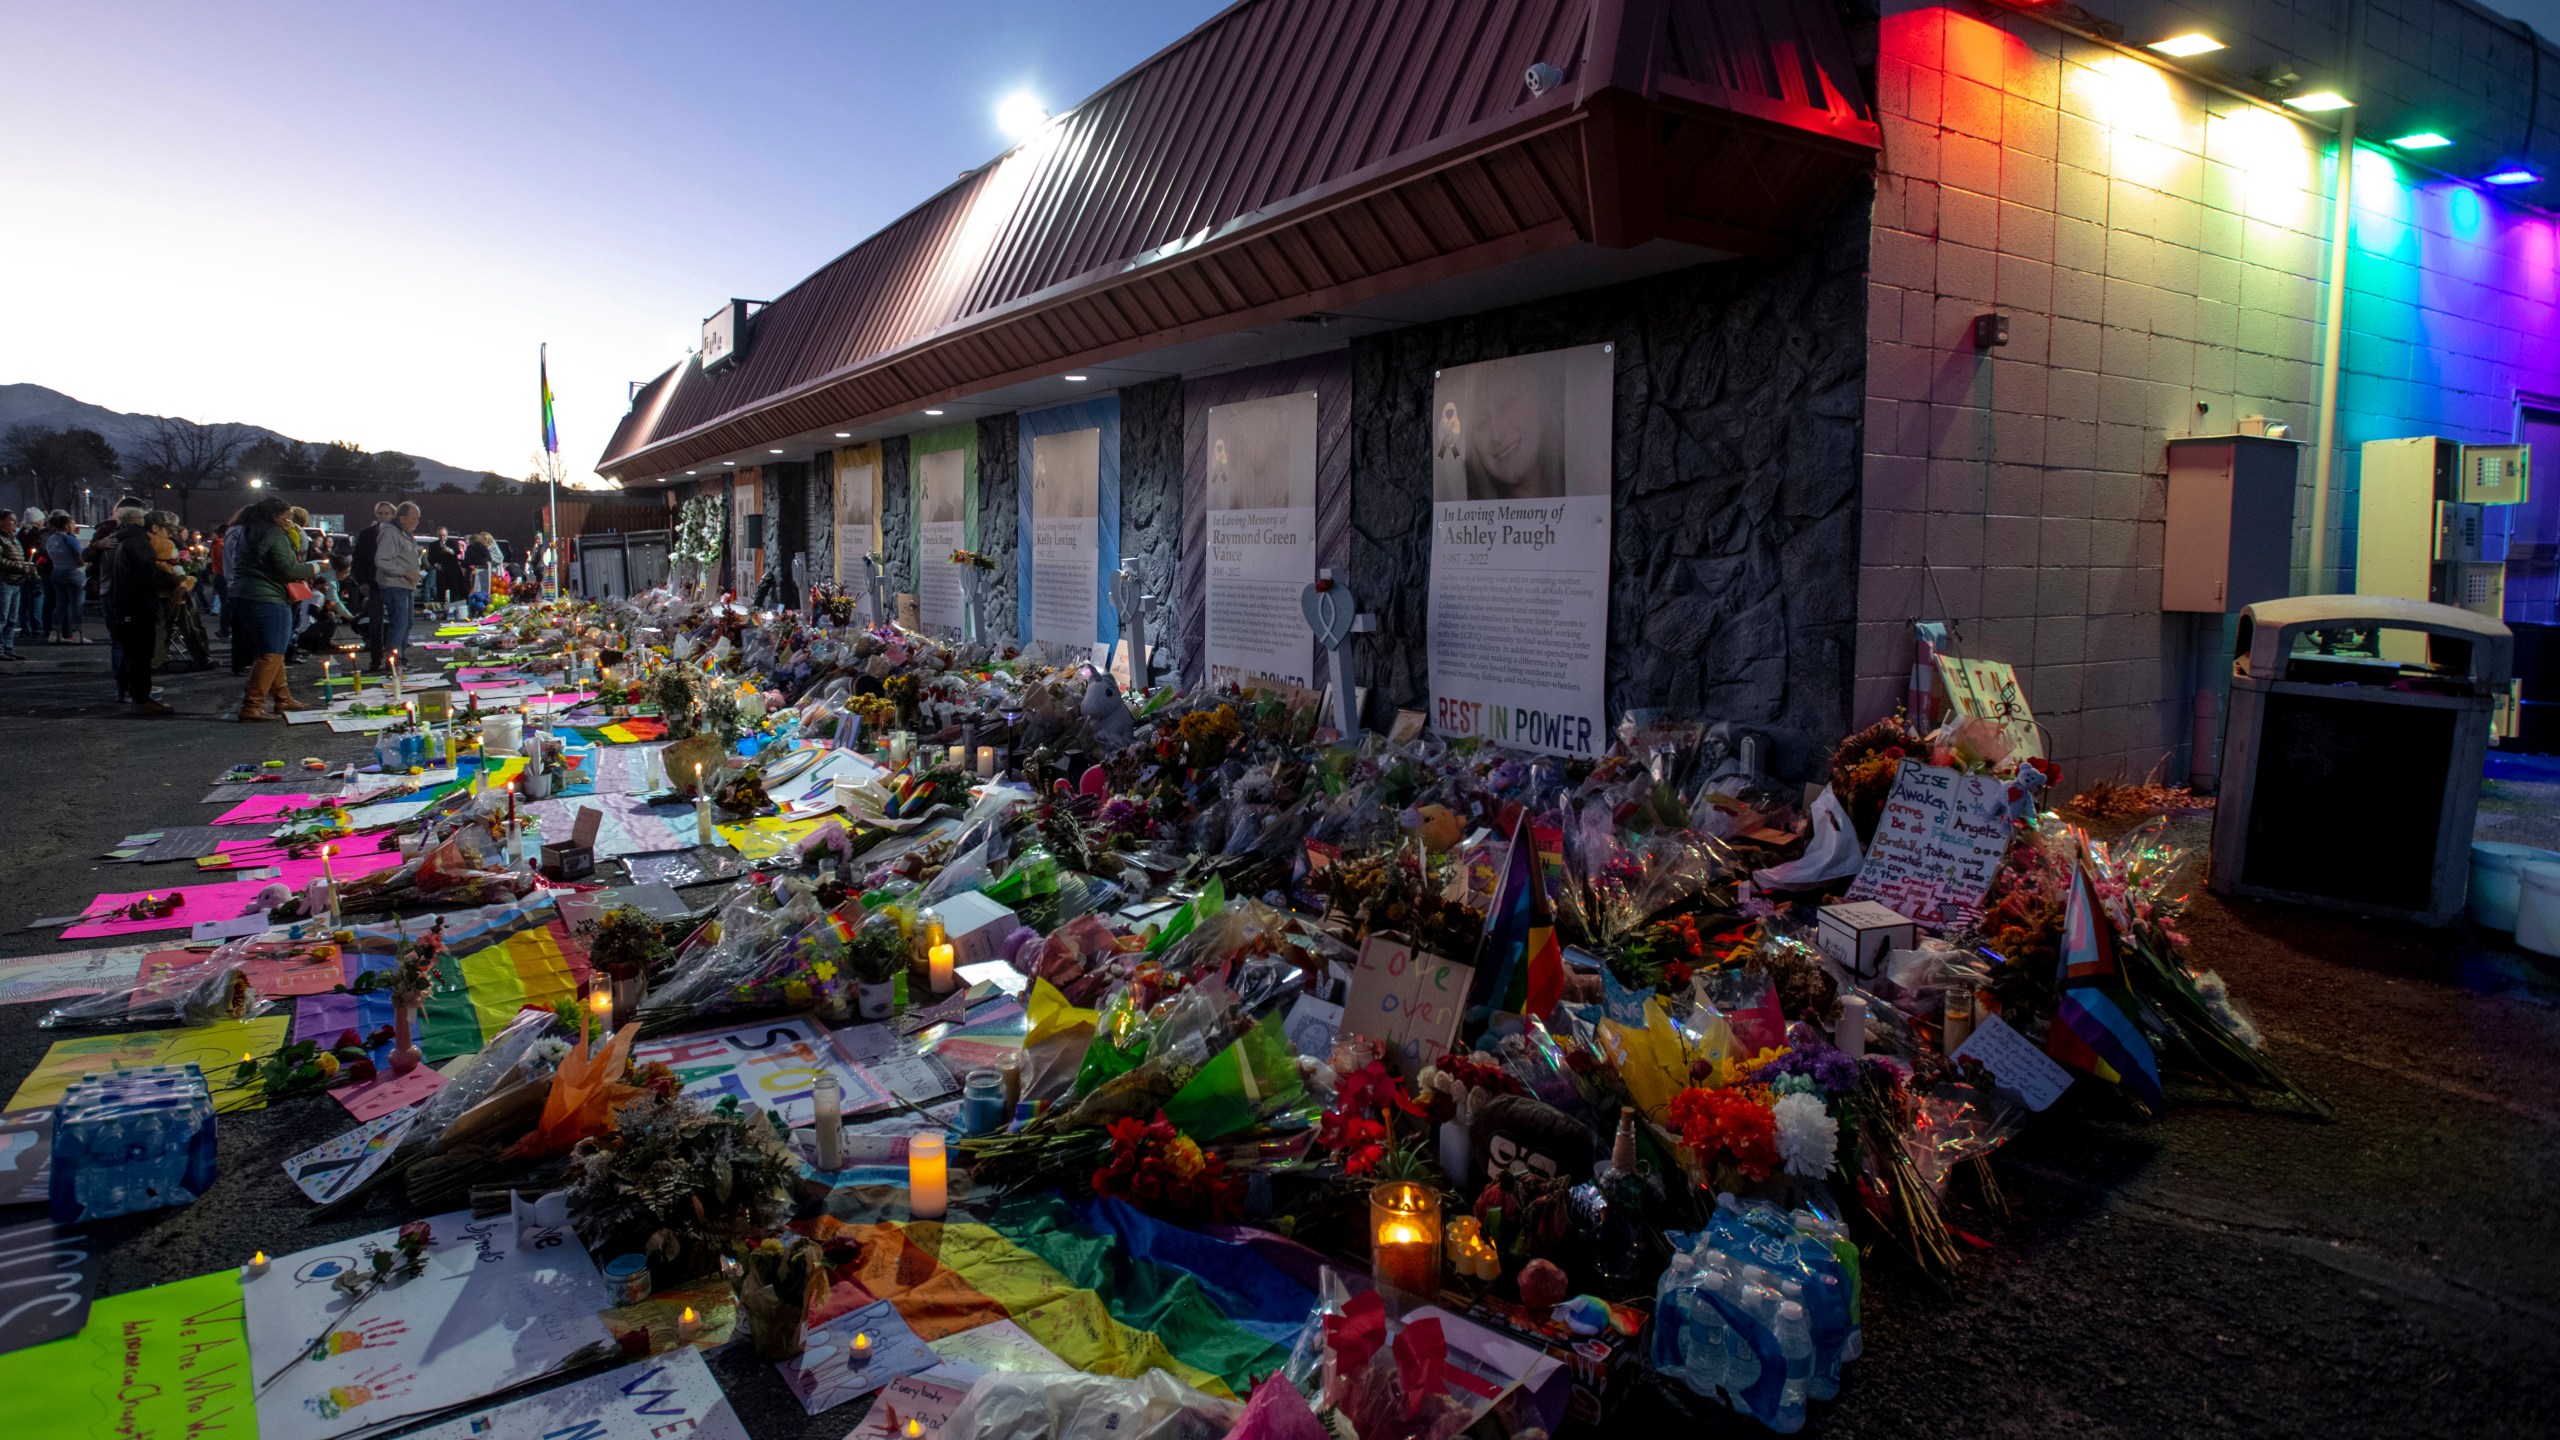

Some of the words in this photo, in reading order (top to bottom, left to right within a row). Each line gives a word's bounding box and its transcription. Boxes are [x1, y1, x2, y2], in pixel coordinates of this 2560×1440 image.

[1213, 515, 1220, 526] In
[1222, 514, 1246, 529] Loving
[1248, 514, 1278, 529] Memory
[1280, 513, 1288, 528] of
[1444, 508, 1454, 521] In
[1457, 507, 1495, 525] Loving
[1497, 506, 1547, 524] Memory
[1551, 504, 1565, 524] of
[1037, 533, 1053, 549] Kelly
[1054, 532, 1077, 550] Loving
[1213, 529, 1260, 549] Raymond
[1263, 529, 1297, 545] Green
[1444, 525, 1497, 551] Ashley
[1502, 524, 1556, 551] Paugh
[1213, 546, 1242, 561] Vance
[1441, 554, 1461, 565] 1987
[1468, 553, 1489, 565] 2022
[1228, 567, 1241, 577] 2022
[1526, 586, 1540, 594] work
[1549, 587, 1564, 595] Kids
[1565, 588, 1594, 597] Crossing
[1516, 606, 1527, 614] and
[1528, 608, 1560, 617] encourage
[1554, 618, 1577, 628] parents
[1460, 632, 1480, 643] LGBTQ
[1537, 638, 1570, 649] welcoming
[1526, 627, 1552, 636] included
[1554, 629, 1581, 640] working
[1510, 646, 1535, 655] addition
[1544, 649, 1572, 660] spending
[1470, 662, 1488, 672] Ashley
[1507, 665, 1522, 676] being
[1524, 667, 1551, 677] outdoors
[1553, 670, 1565, 678] and
[1518, 656, 1548, 666] difference
[1557, 660, 1567, 668] her
[1516, 676, 1535, 687] riding
[1438, 696, 1483, 735] REST
[1489, 705, 1508, 741] IN
[1515, 708, 1592, 753] POWER
[1900, 759, 1950, 790] RISE
[1890, 783, 1949, 811] Awaken
[1957, 801, 1967, 812] in
[1891, 816, 1906, 830] Be
[1924, 843, 1955, 862] taken
[1958, 857, 1984, 871] away
[1880, 870, 1899, 881] the
[1359, 936, 1450, 992] Love
[1381, 992, 1453, 1025] over
[636, 1038, 752, 1100] HAT
[290, 1150, 318, 1165] LOVE
[320, 1132, 356, 1152] UNITES
[357, 1126, 369, 1135] US
[177, 1337, 238, 1371] Are
[620, 1366, 698, 1439] WE
